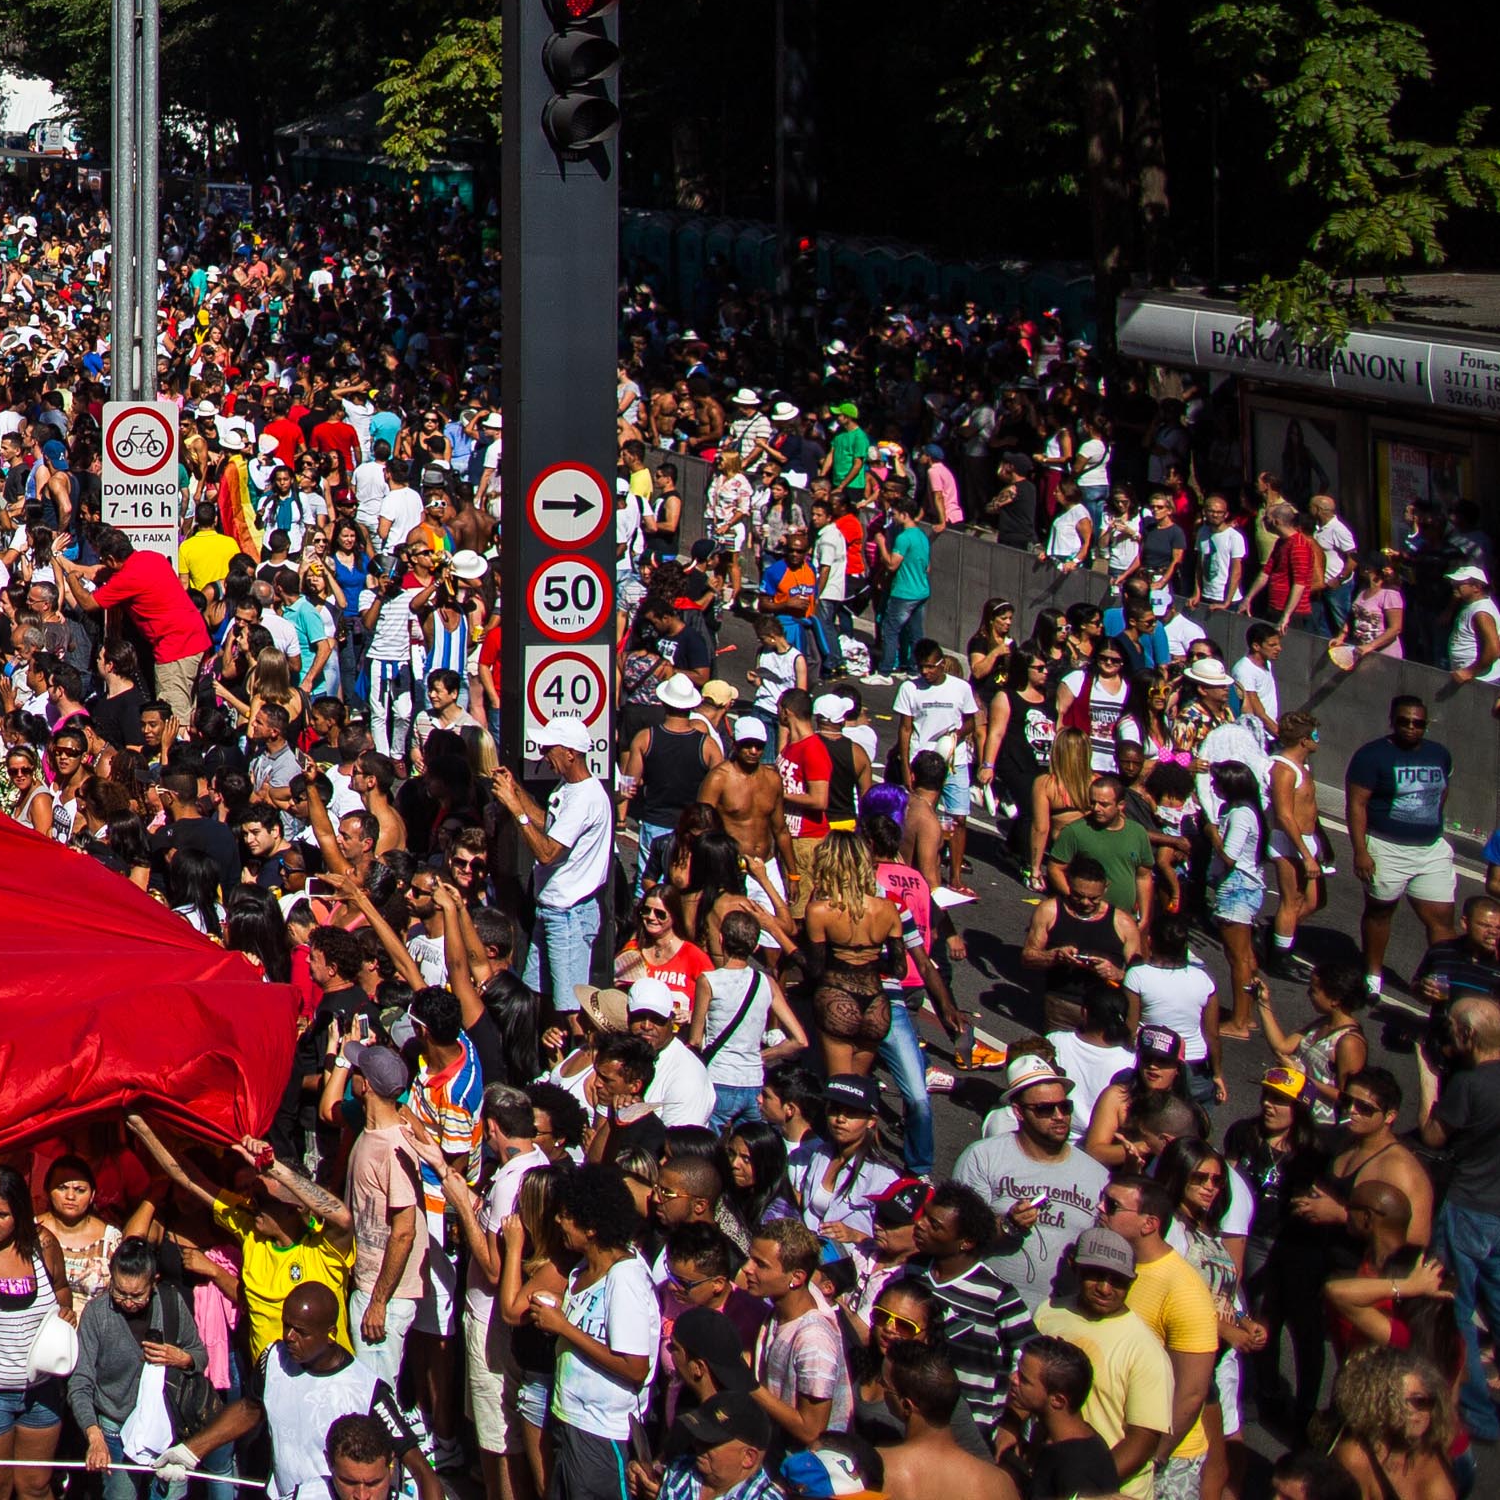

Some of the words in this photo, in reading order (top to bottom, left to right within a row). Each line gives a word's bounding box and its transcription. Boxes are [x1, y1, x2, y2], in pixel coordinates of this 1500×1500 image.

[1211, 330, 1289, 366] BANCA
[1293, 343, 1406, 383] TRIANON
[1443, 369, 1479, 389] 3171
[103, 483, 176, 496] DOMINGO
[108, 501, 153, 518] 7-16
[160, 501, 172, 517] h
[142, 533, 172, 542] FAIXA
[543, 574, 597, 612] 50
[552, 615, 585, 625] km/h
[542, 674, 592, 705] 40
[552, 708, 582, 718] km/h
[888, 874, 921, 890] STAFF
[996, 1175, 1097, 1213] Abercrombie
[576, 1316, 607, 1342] ALL
